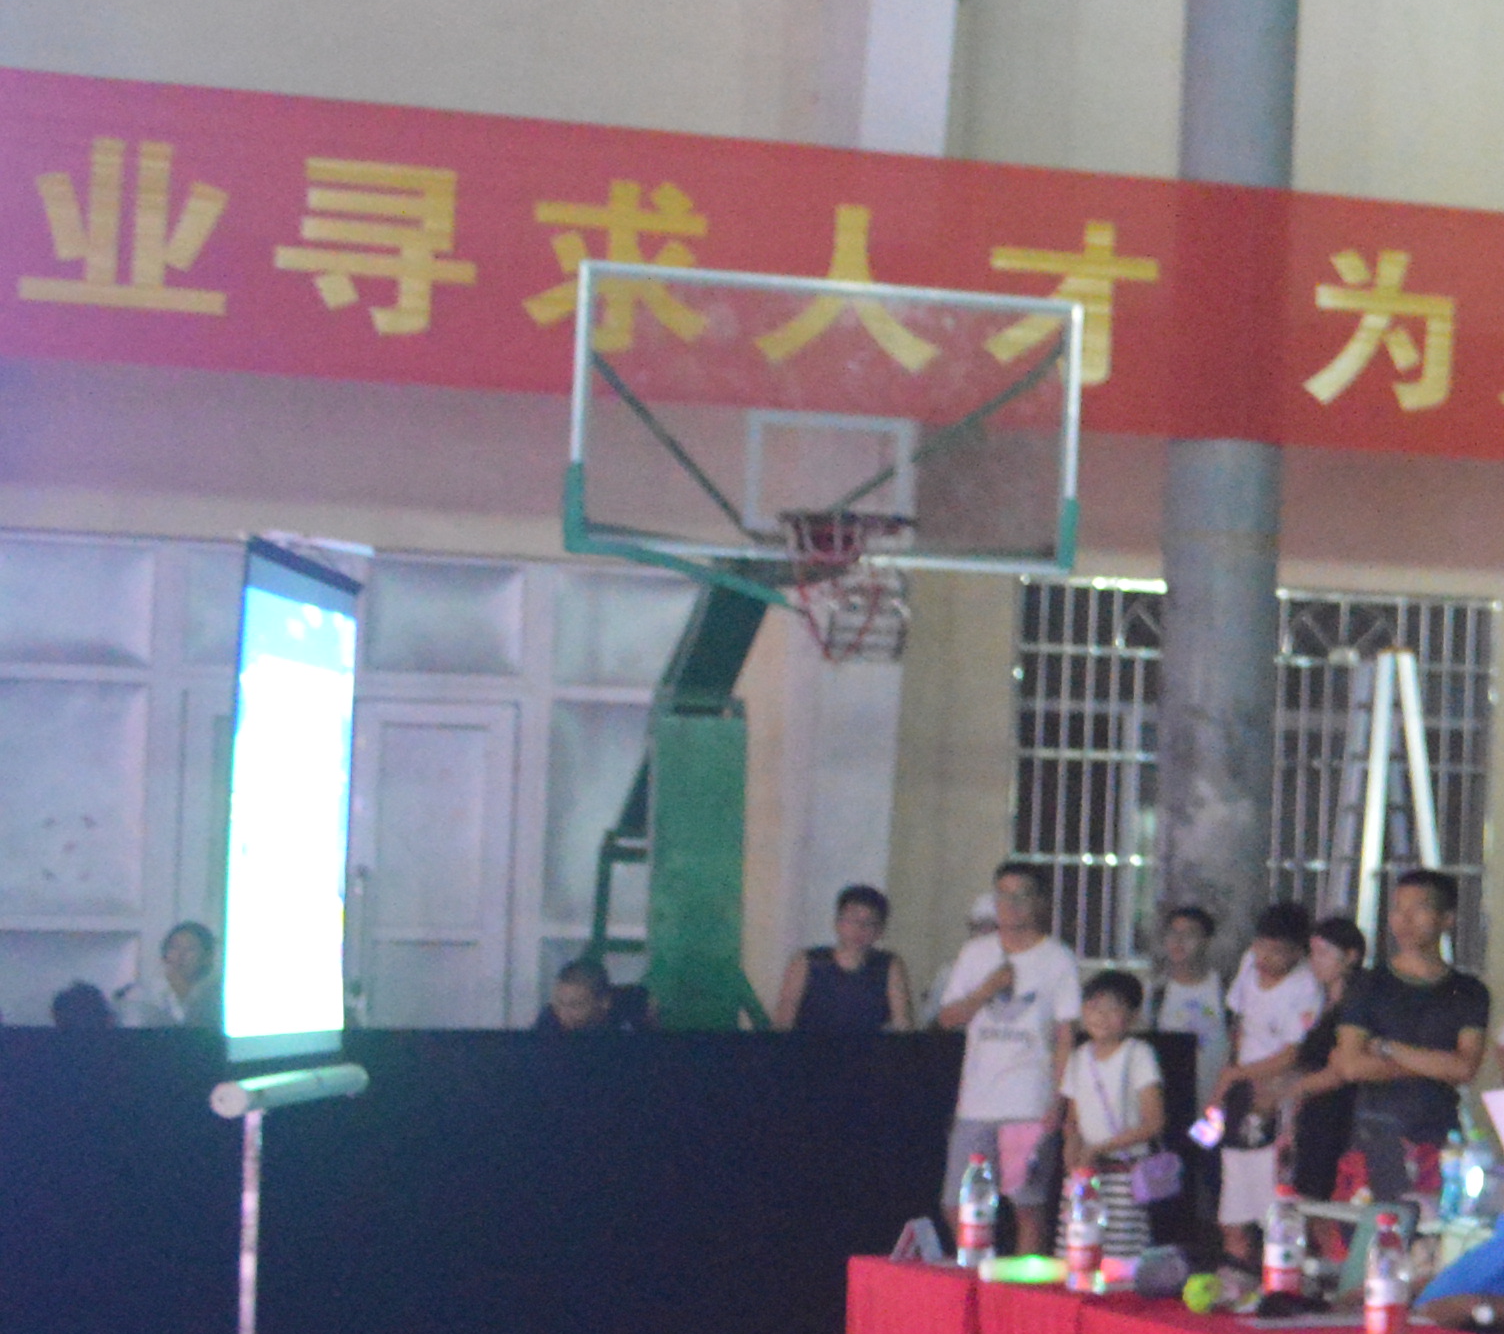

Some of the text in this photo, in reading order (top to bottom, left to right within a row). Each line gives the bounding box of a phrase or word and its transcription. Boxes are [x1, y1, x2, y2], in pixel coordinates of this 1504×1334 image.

[18, 137, 1160, 386] 业寻求人才
